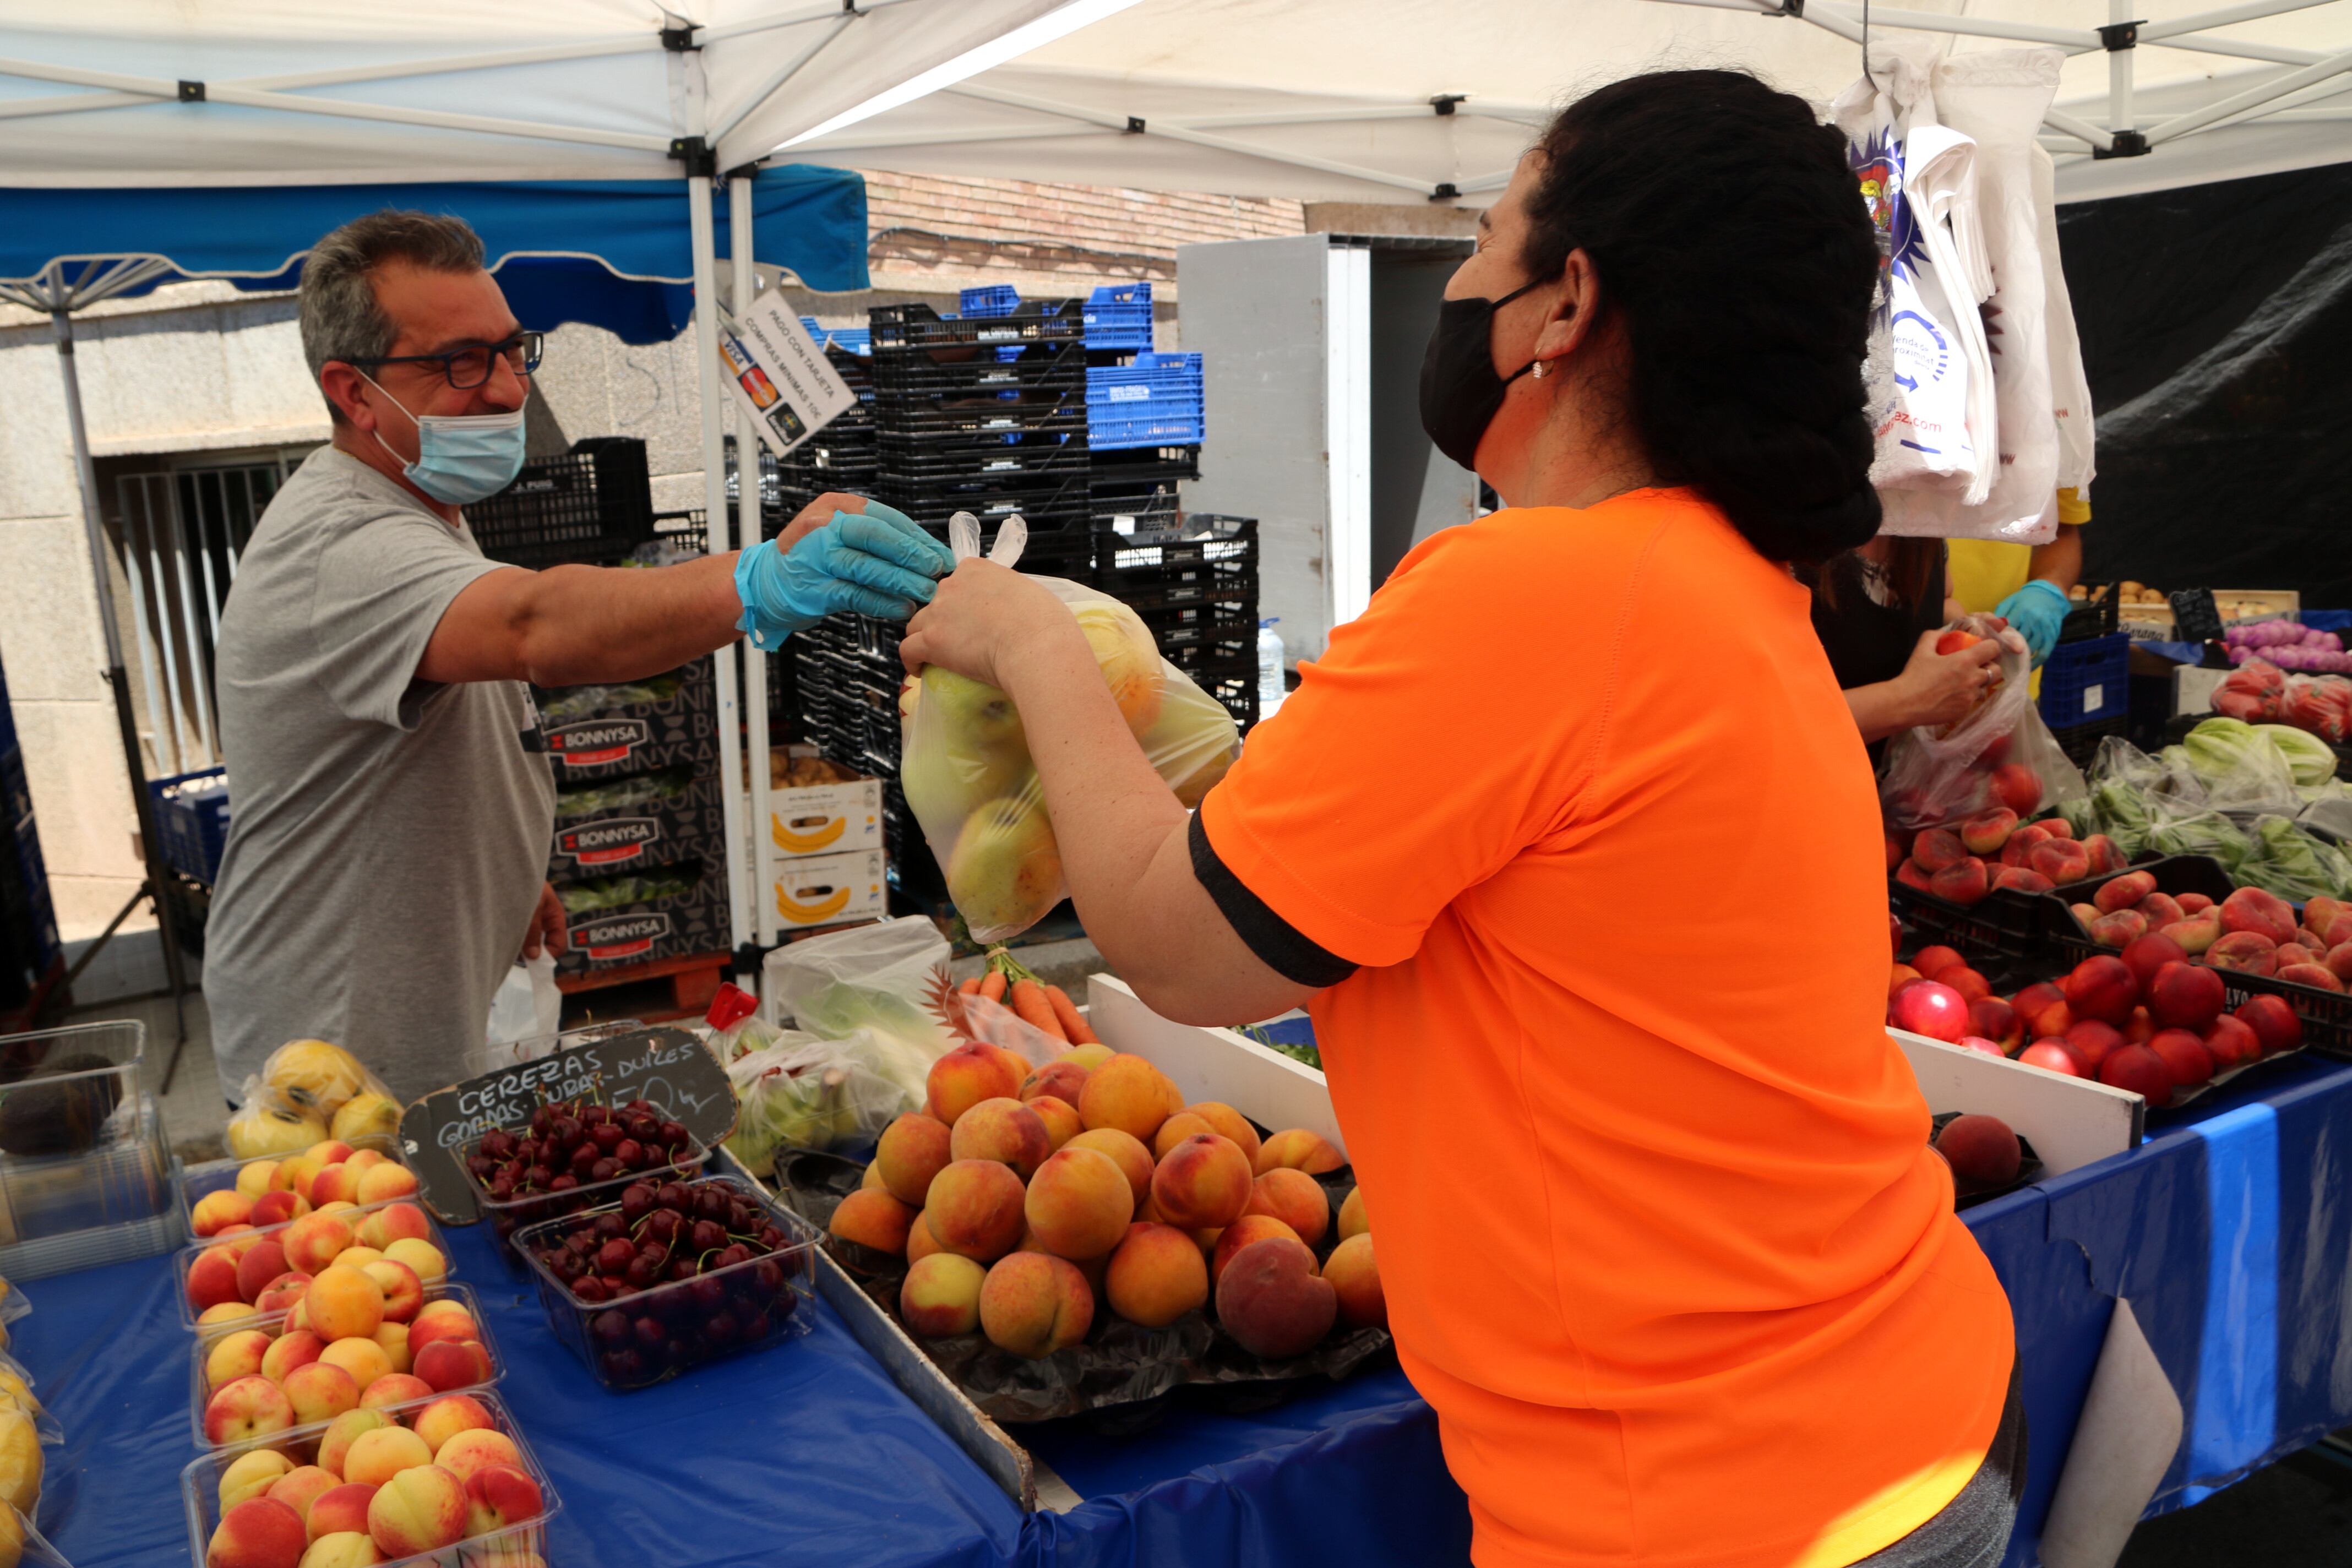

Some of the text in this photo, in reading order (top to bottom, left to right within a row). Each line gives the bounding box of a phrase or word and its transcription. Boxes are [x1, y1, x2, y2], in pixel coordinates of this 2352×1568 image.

[725, 340, 744, 366] VISA
[745, 317, 780, 364] COMPRAS
[777, 363, 808, 402] MINIMAS
[769, 309, 835, 399] PAGO CON TARJETA
[1893, 347, 1934, 366] roximitat
[565, 725, 639, 748] BONNYSA
[578, 824, 650, 847] BONNYSA
[589, 919, 660, 943] BONNYSA
[458, 1049, 603, 1115] CEREZAS
